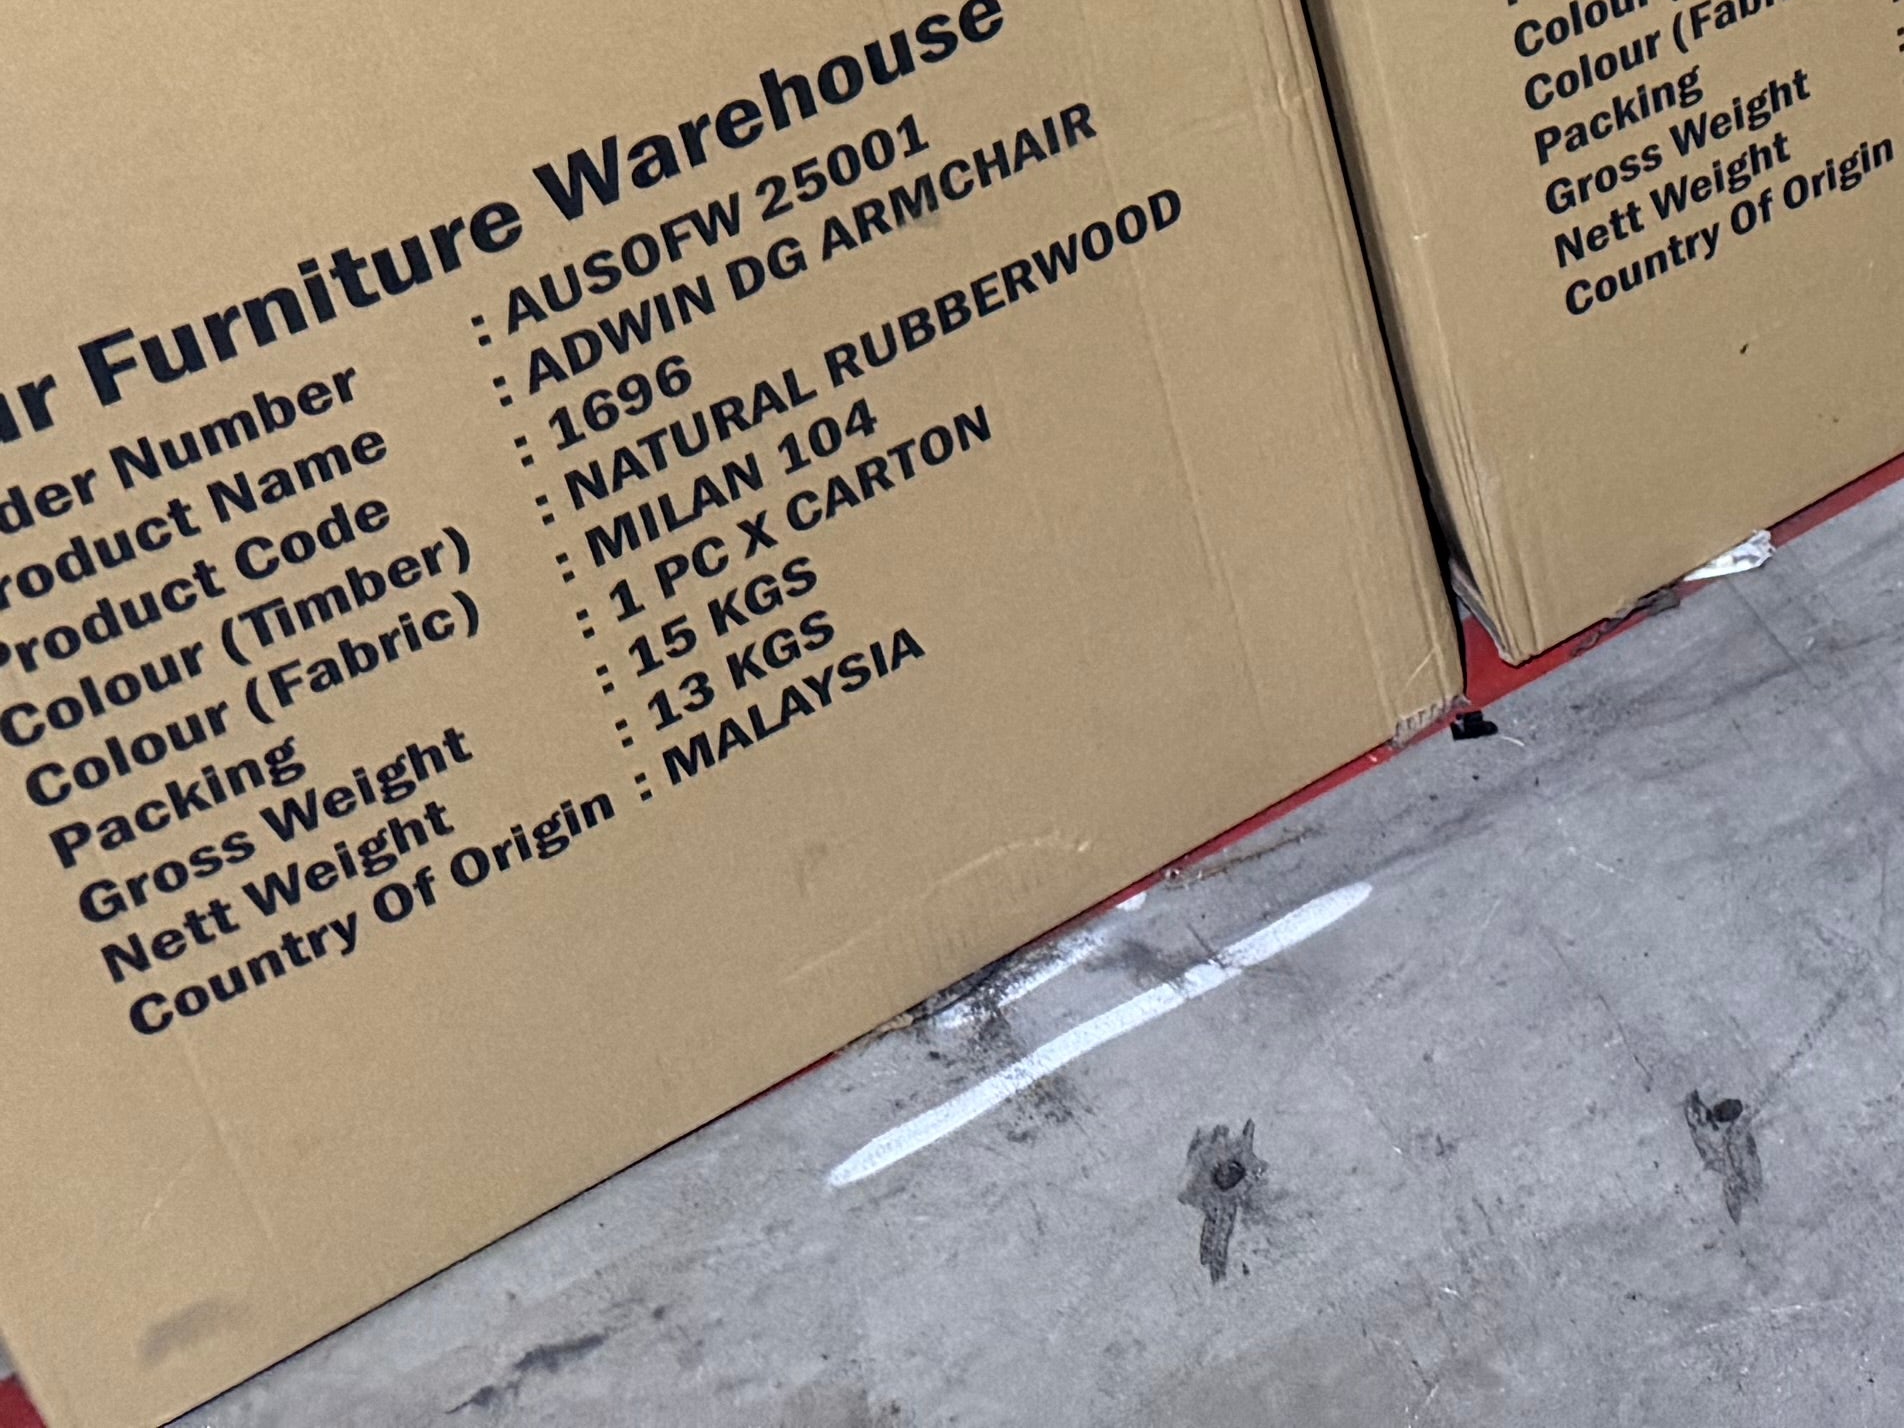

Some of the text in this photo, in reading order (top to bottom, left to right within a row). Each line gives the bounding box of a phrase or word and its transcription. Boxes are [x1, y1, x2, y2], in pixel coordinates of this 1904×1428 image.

[77, 201, 523, 407] Furniture
[1565, 222, 1720, 316] Country
[1730, 187, 1773, 236] Of
[1782, 138, 1894, 210] Origin
[0, 188, 1182, 748] Colour (Timber) NATURAL RUBBERWOOD
[25, 397, 878, 807] Colour (Fabric) MILAN 104
[48, 404, 992, 870] Packing 1 PC X CARTON
[100, 609, 835, 984] Nett Weight 13 KGS
[129, 627, 926, 1036] Country Of Origin MALAYSIA
